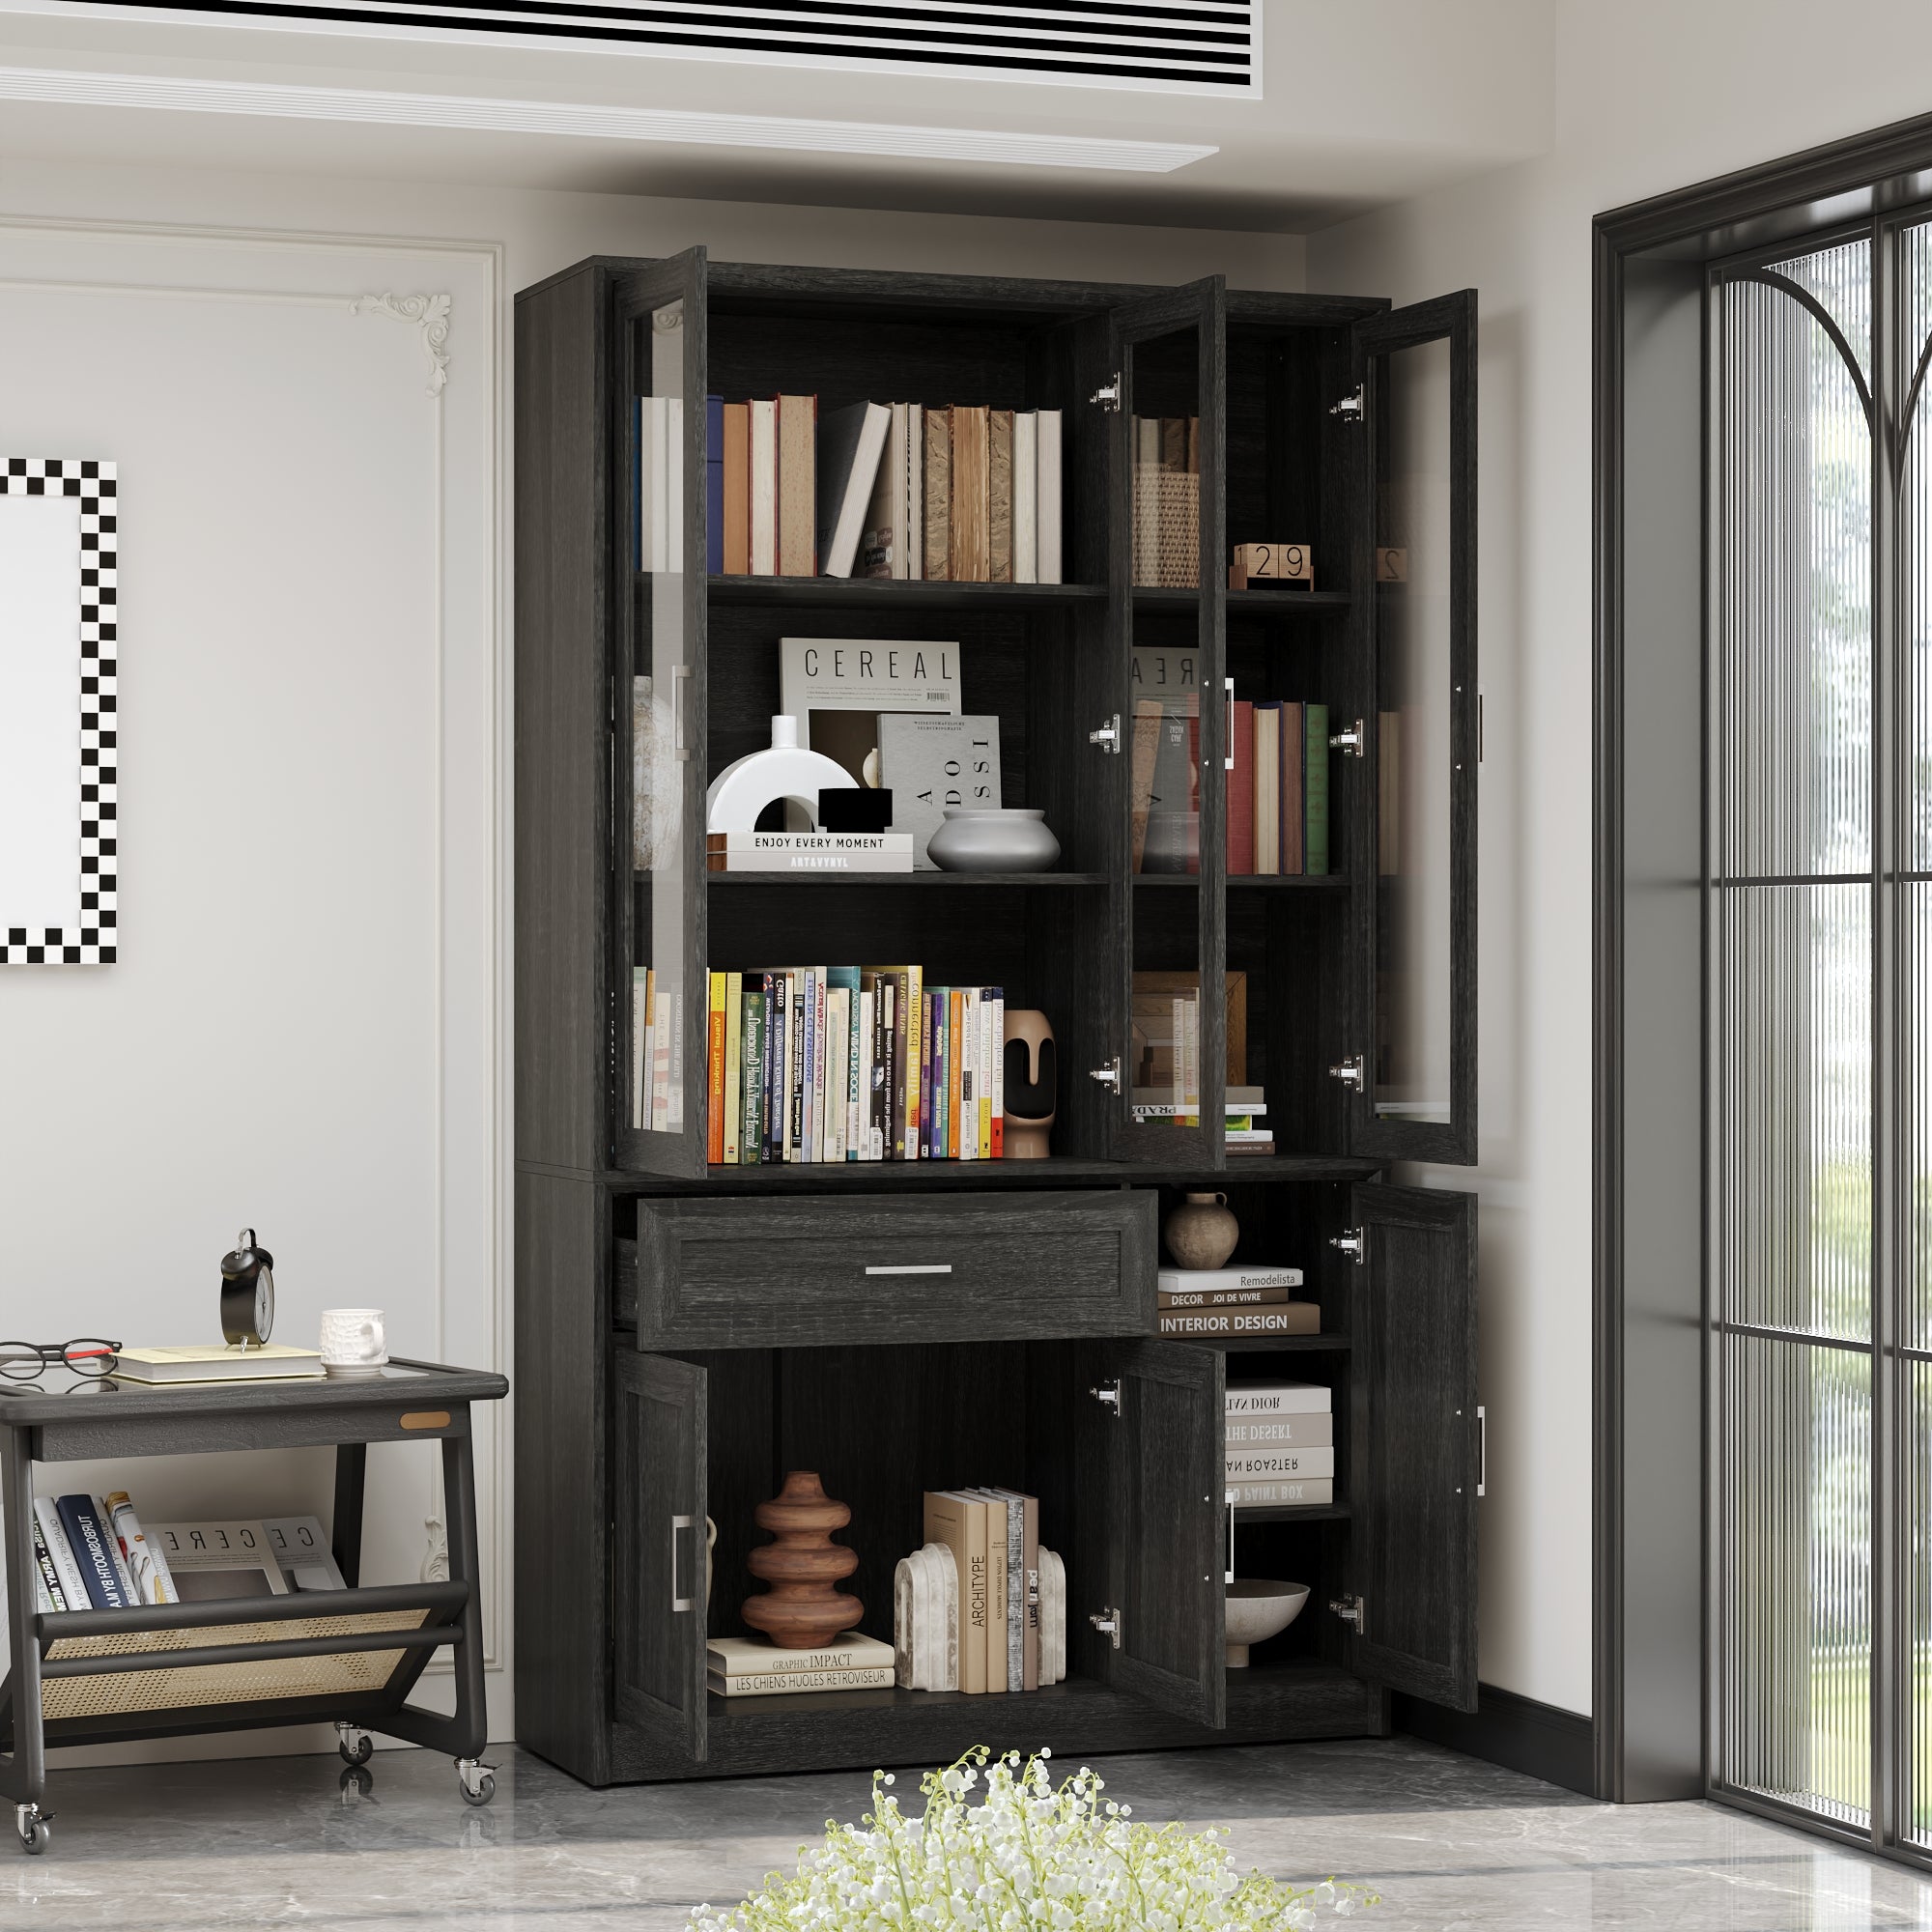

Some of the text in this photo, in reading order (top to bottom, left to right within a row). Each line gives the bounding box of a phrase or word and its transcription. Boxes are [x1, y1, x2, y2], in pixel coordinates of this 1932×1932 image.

[805, 648, 953, 681] CEREAL
[754, 838, 885, 849] ENJOY EVERY MOMENT
[1240, 1273, 1296, 1288] Remodelista
[1171, 1293, 1262, 1306] DECOR JOI DE VIVRE
[1159, 1314, 1289, 1333] INTERIOR DESIGN
[972, 1555, 985, 1628] ARCHITYPE
[1027, 1569, 1039, 1602] pearl
[772, 1653, 853, 1670] GRAPHIC IMPACT
[736, 1669, 886, 1690] LES CHIENS HUOLES RETROVISEUR
